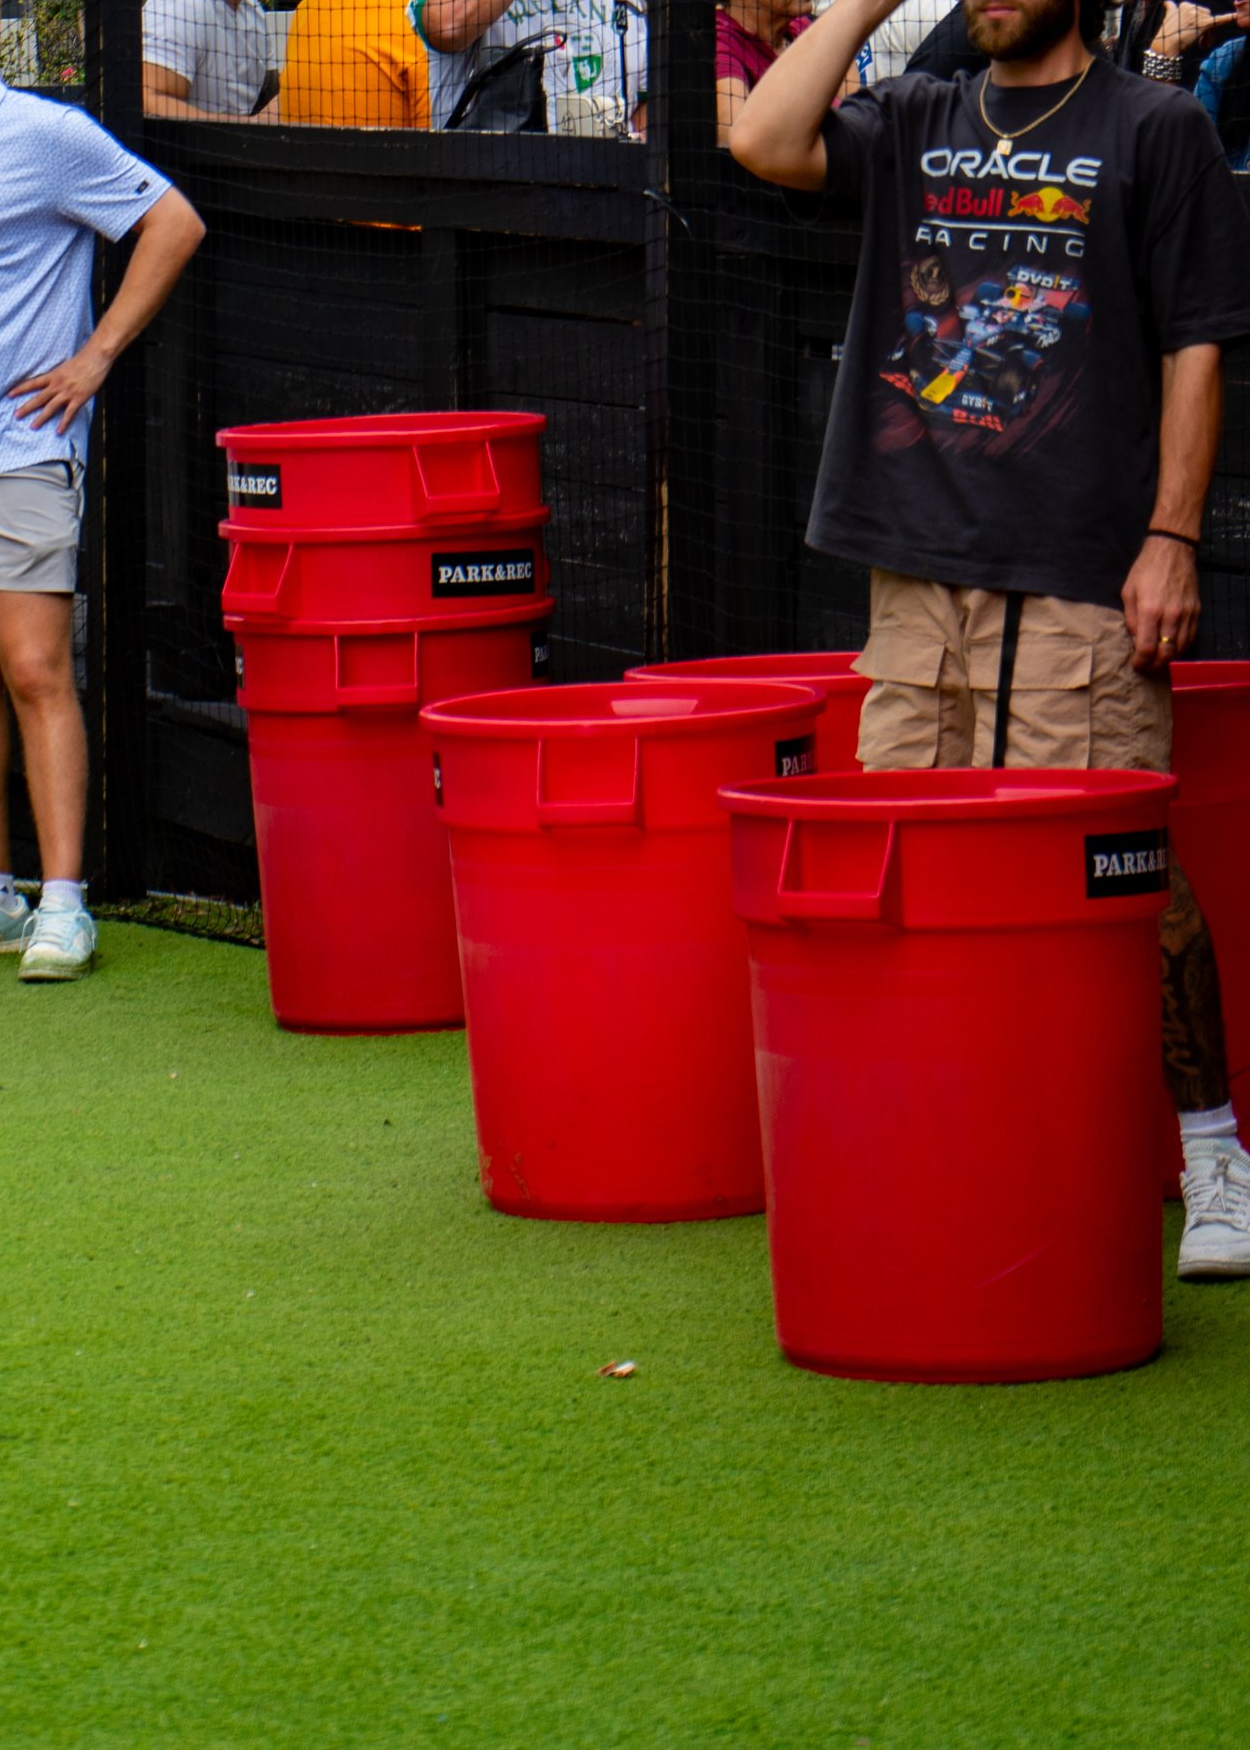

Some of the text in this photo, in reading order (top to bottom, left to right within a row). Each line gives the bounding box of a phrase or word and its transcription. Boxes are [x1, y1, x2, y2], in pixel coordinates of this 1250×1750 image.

[920, 148, 1103, 188] ORACLE
[924, 186, 1005, 217] ed Bull
[915, 225, 1085, 259] RACING
[438, 561, 532, 584] PARK&REC
